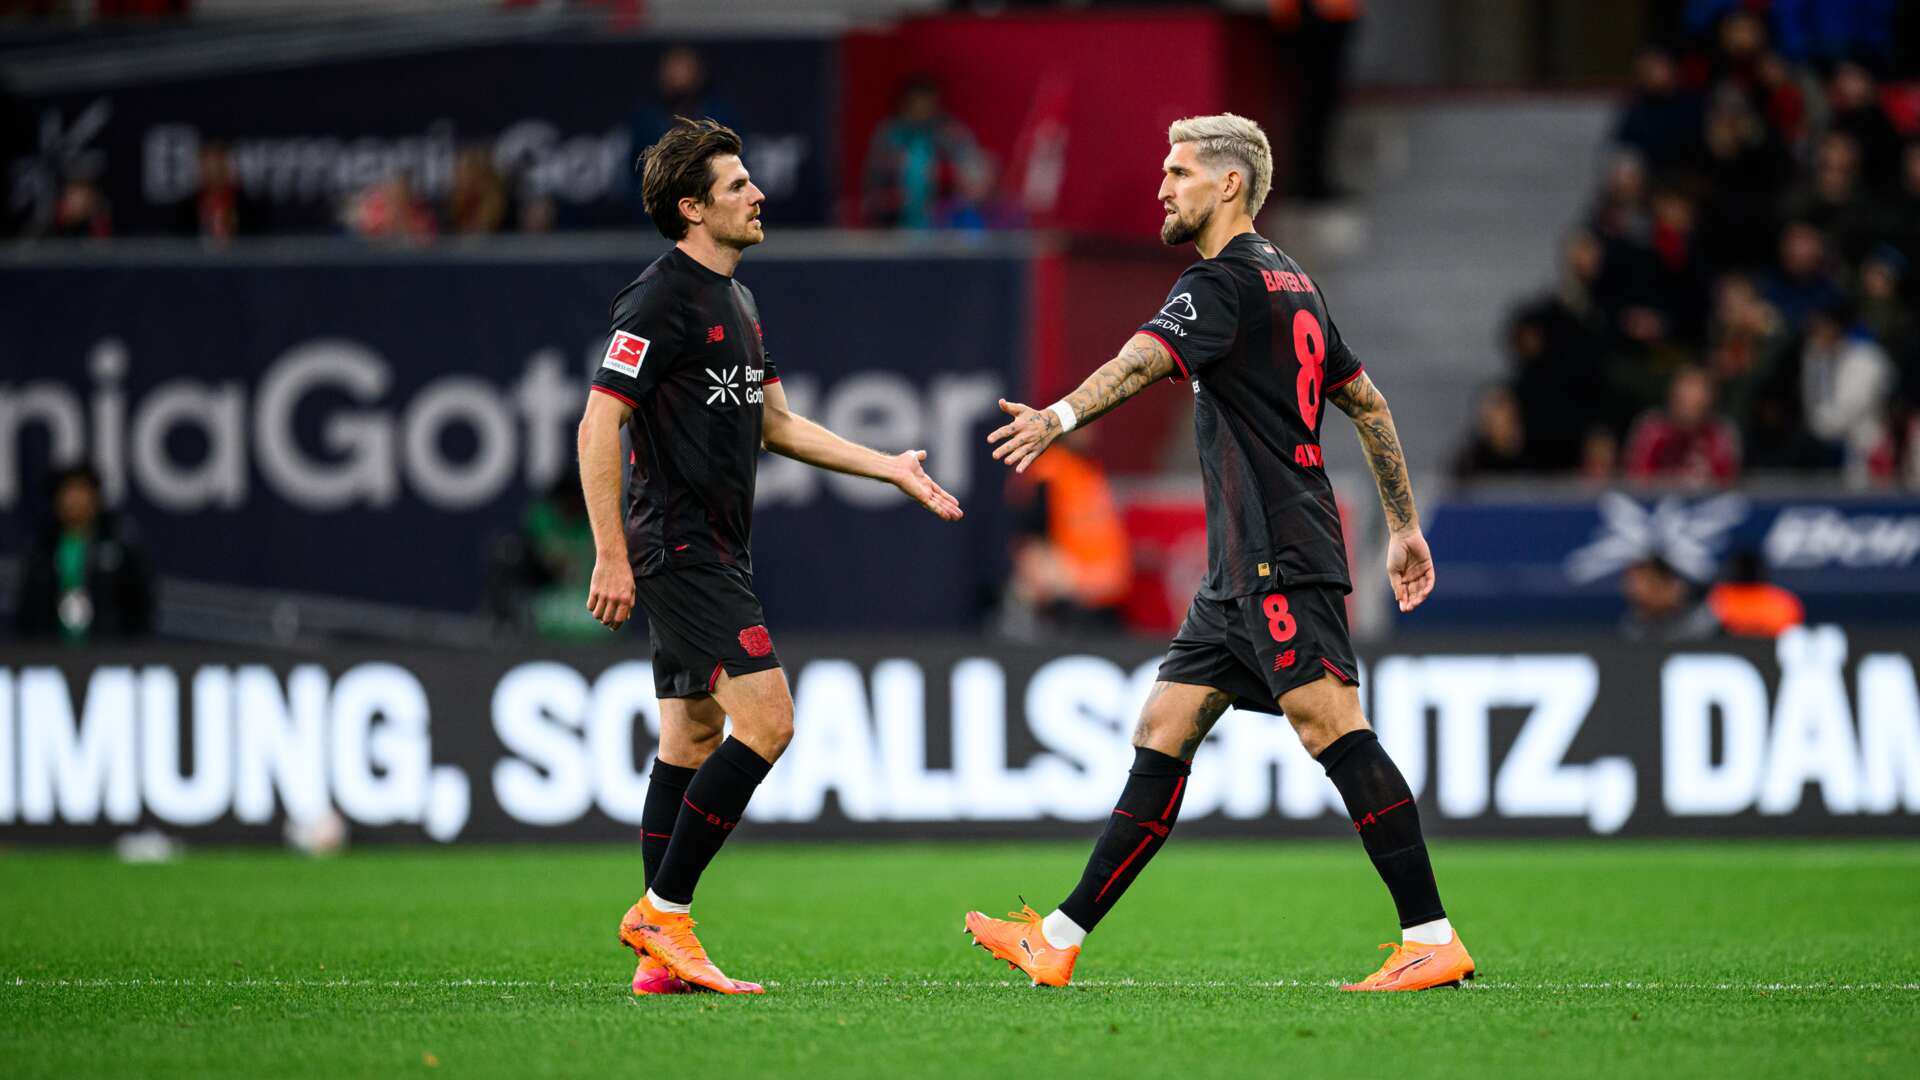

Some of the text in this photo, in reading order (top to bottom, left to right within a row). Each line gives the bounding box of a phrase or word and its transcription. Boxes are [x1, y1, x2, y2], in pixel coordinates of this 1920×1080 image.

[0, 335, 1006, 514] niaGoter
[1292, 308, 1326, 432] 8
[1262, 593, 1298, 642] 8
